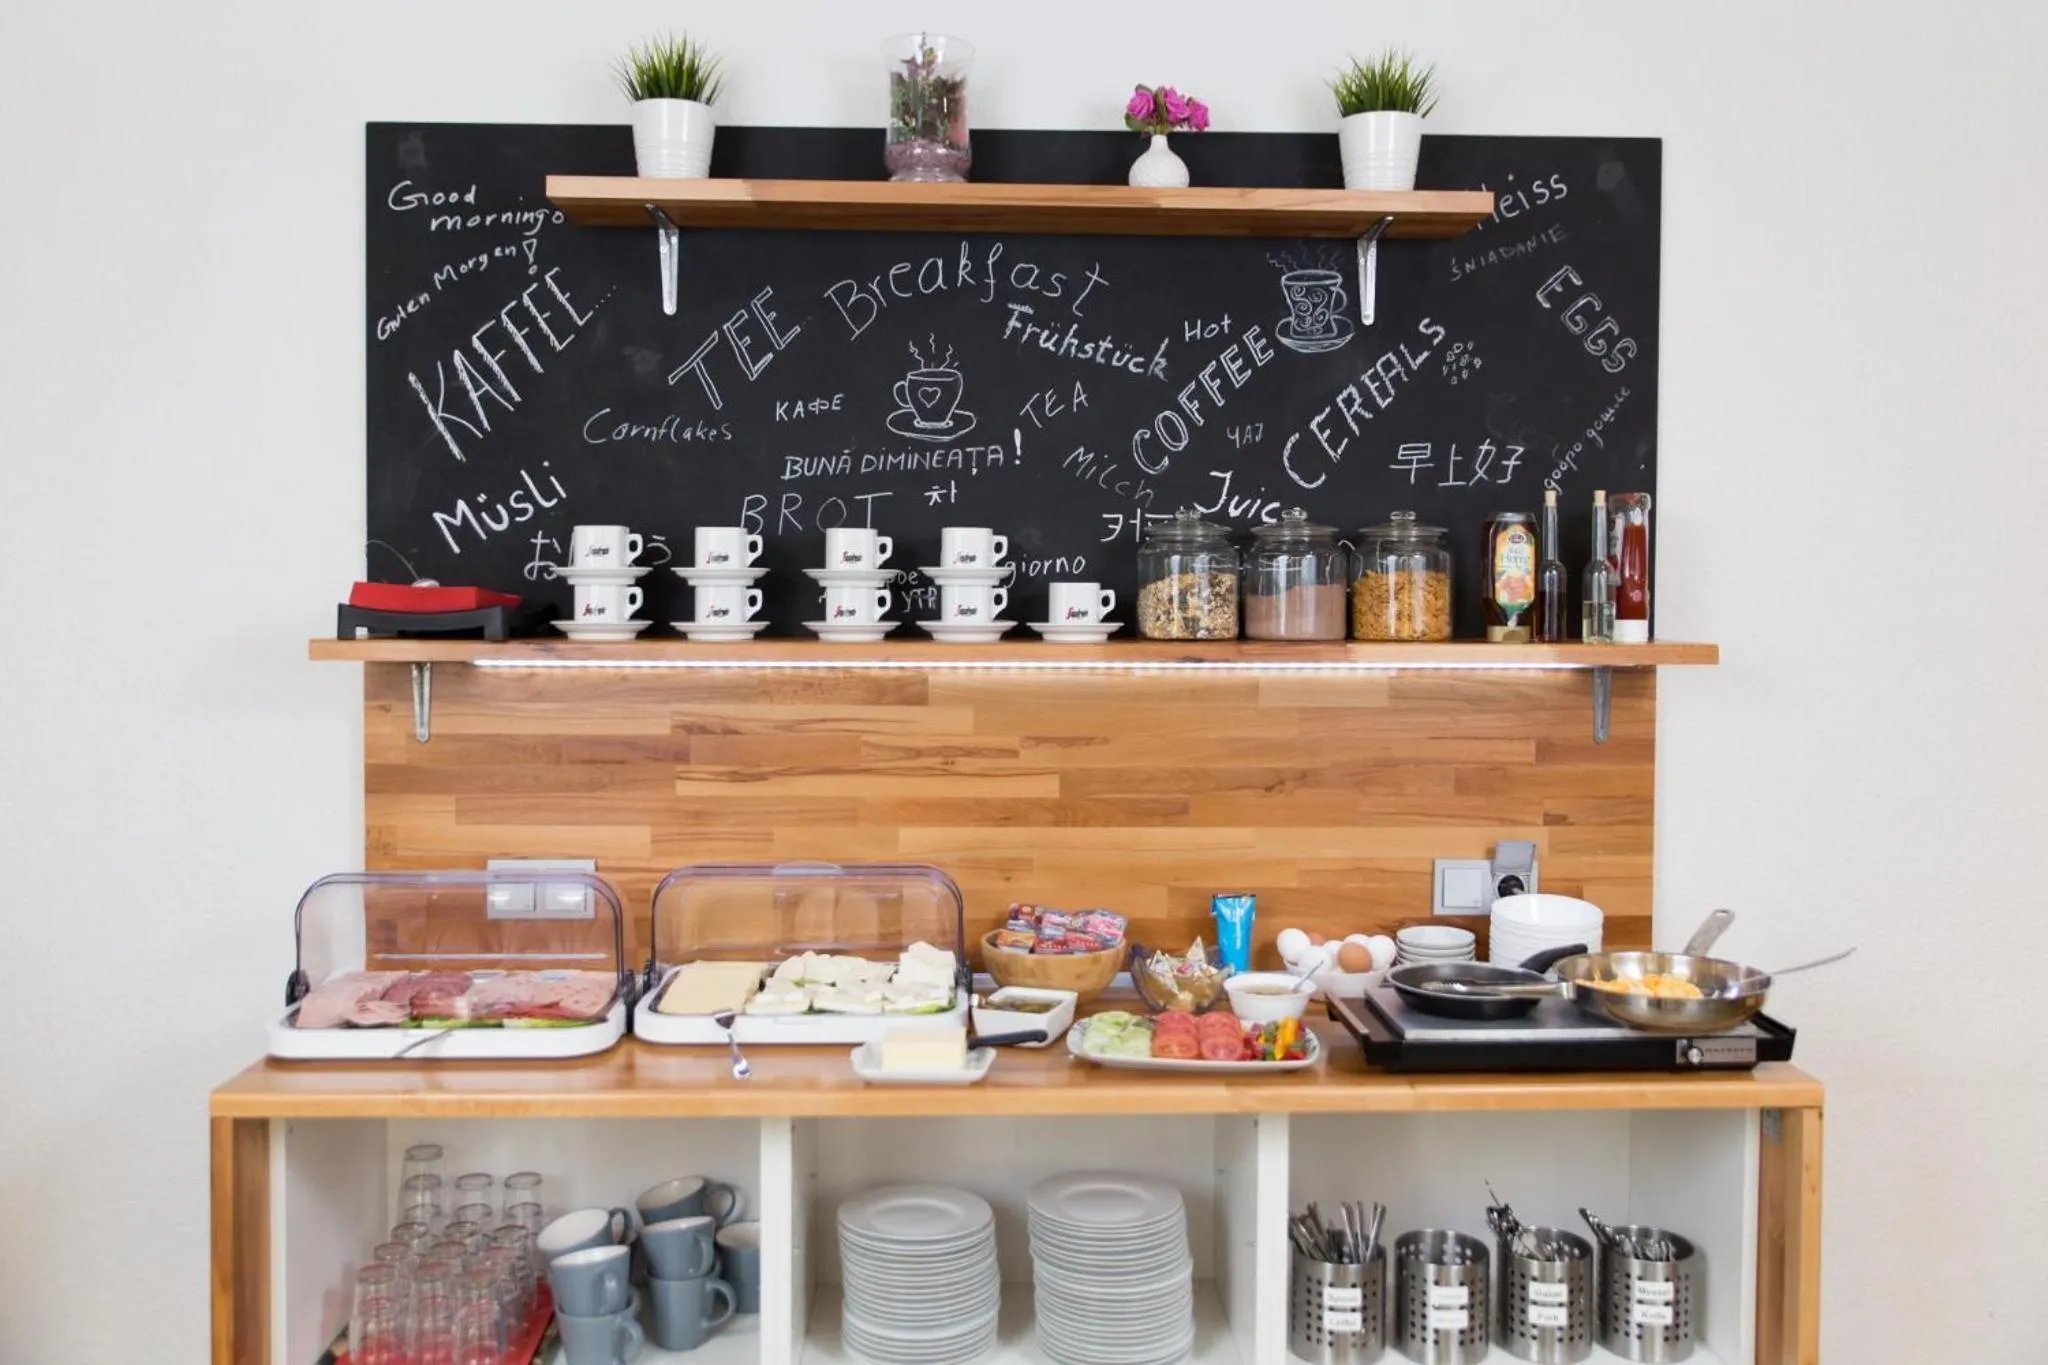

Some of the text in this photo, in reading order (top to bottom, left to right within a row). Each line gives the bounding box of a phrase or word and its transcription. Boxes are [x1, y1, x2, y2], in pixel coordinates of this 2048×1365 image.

[388, 180, 476, 211] Good
[377, 293, 431, 340] Guten
[824, 241, 1109, 341] Breakfast
[1002, 302, 1169, 382] Frühstück
[1185, 313, 1232, 342] Hot
[1536, 264, 1638, 373] EGGS
[668, 286, 801, 410] TEE
[583, 407, 733, 443] Cornflakes
[1020, 381, 1089, 428] TEA
[1132, 325, 1275, 474] COFFEE
[1282, 317, 1446, 489] CEREALS
[1388, 438, 1525, 487] 早上好
[432, 460, 567, 554] Müsli
[739, 492, 893, 538] BROT
[1193, 470, 1281, 524] Juic
